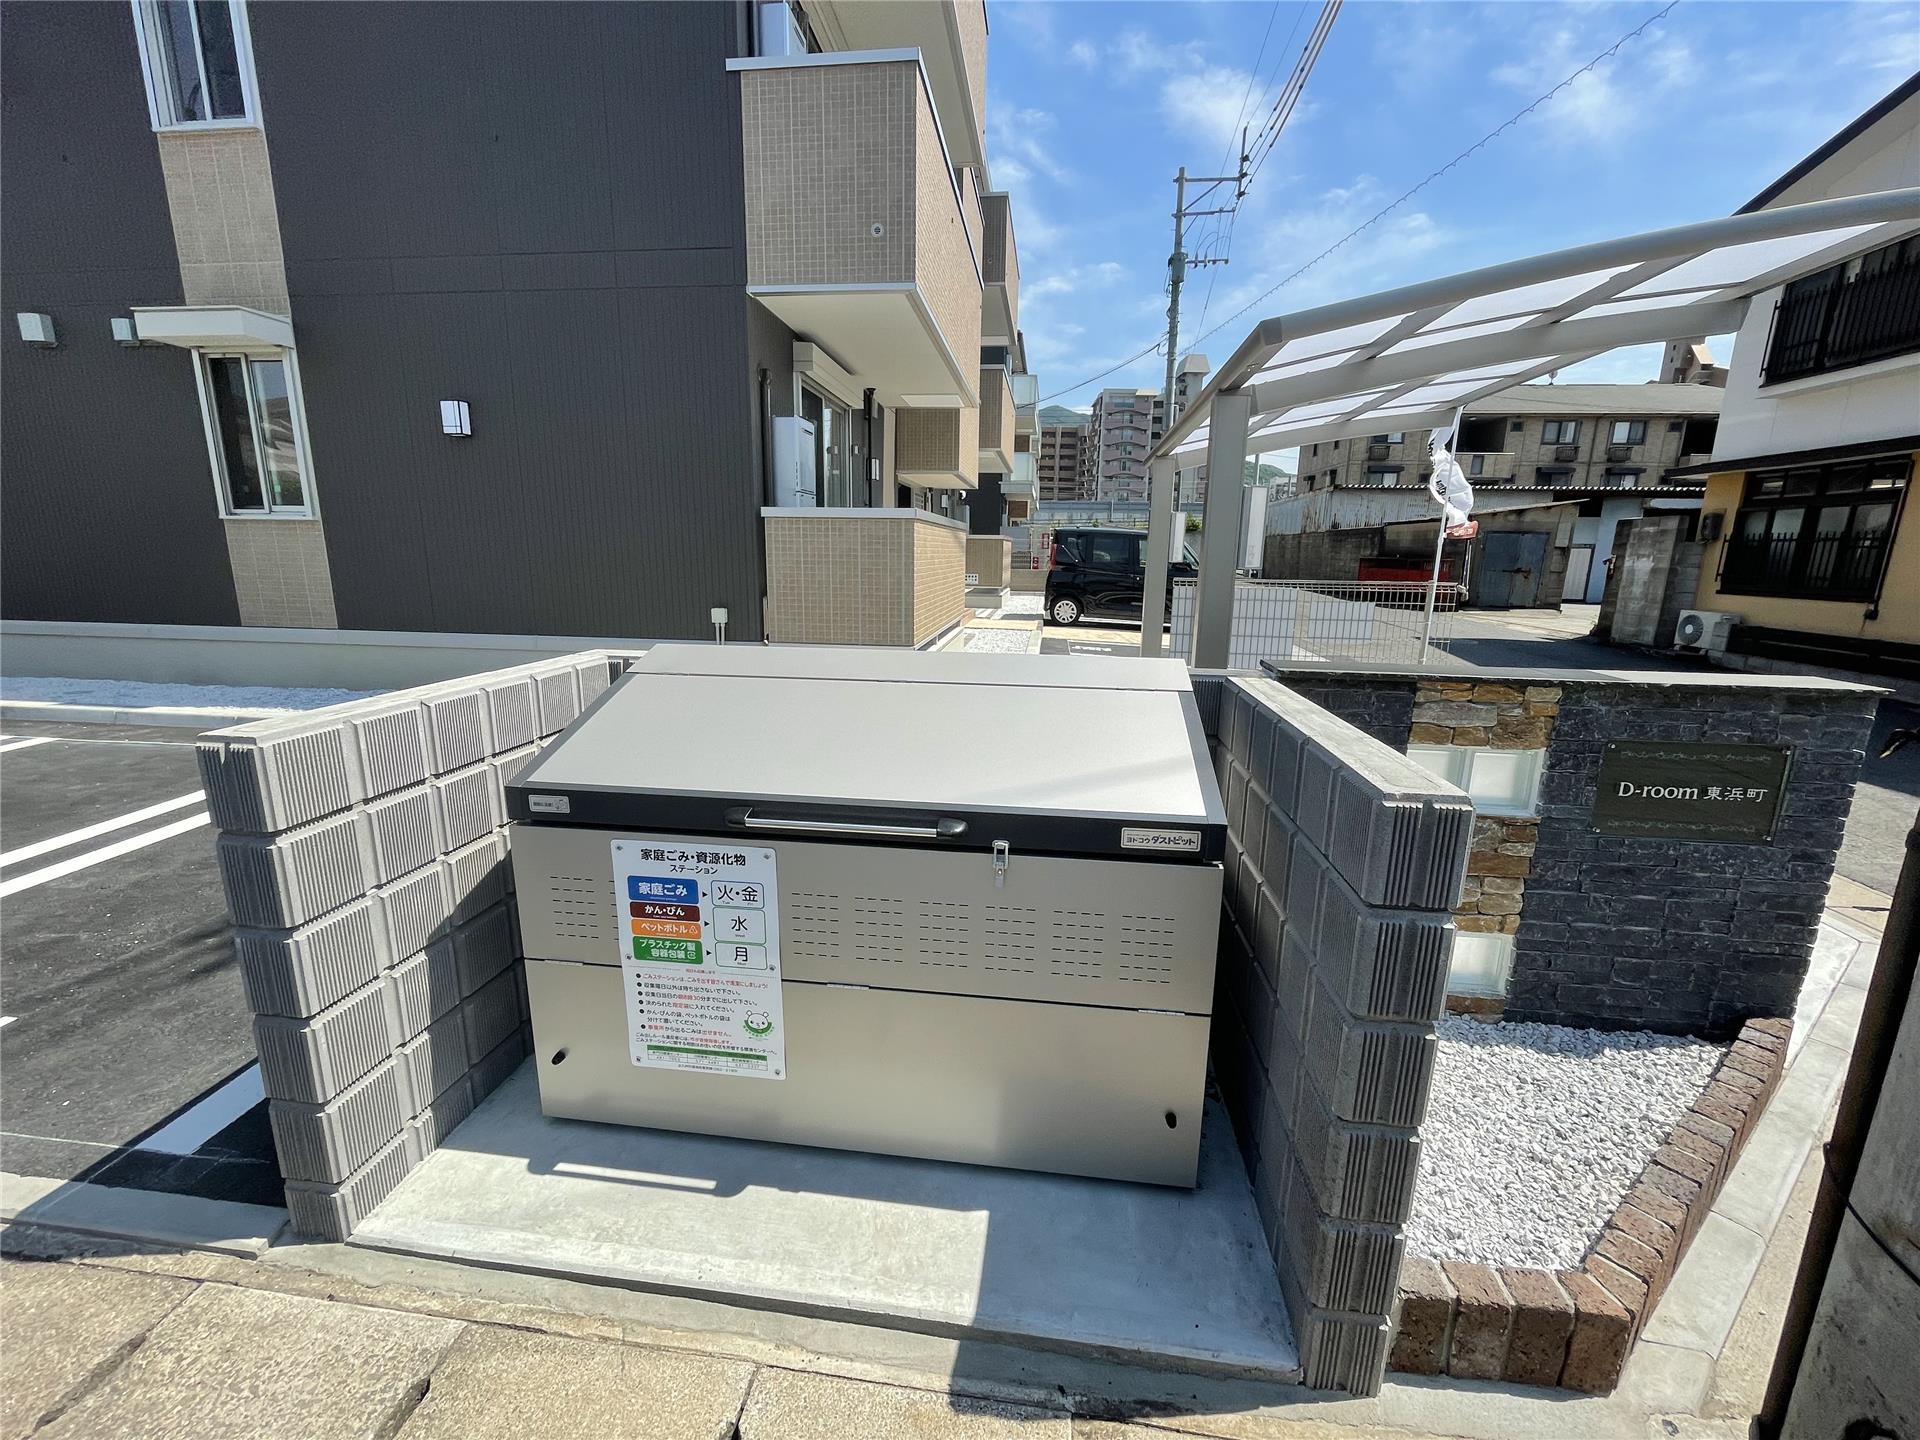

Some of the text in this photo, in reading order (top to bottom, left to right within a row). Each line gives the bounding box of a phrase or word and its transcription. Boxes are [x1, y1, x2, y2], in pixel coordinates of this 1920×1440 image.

[1618, 781, 1768, 803] D-room 東浜町
[640, 848, 746, 866] 家庭ごみ・資源化物
[670, 864, 718, 875] ステーション
[638, 882, 688, 897] 家庭ごみ
[717, 884, 758, 903] 火・金
[644, 905, 685, 917] かん・びん
[641, 922, 689, 934] ペットボトル
[731, 915, 748, 932] 水
[639, 939, 696, 951] プラスチック製
[734, 946, 748, 962] 月
